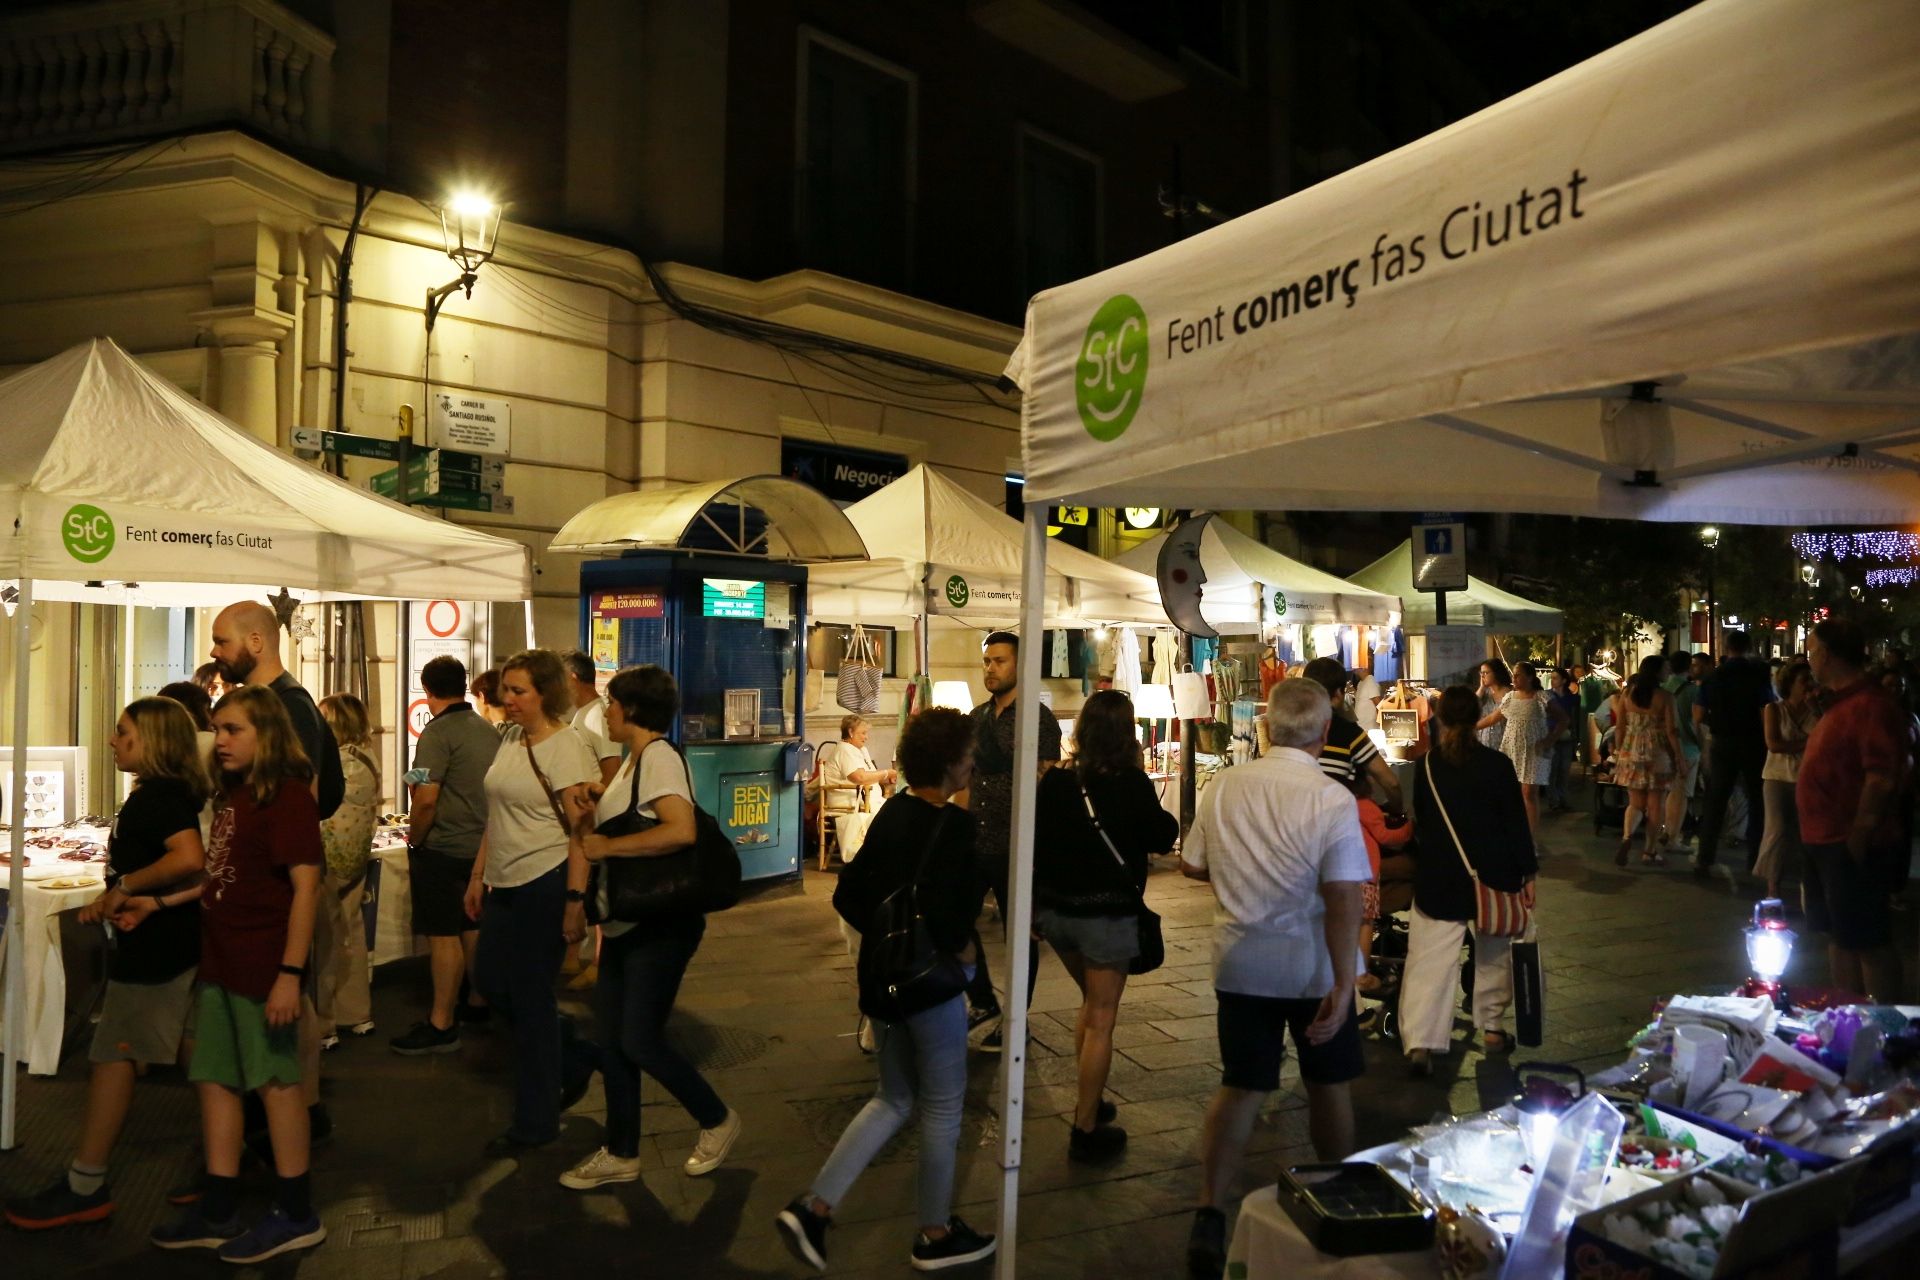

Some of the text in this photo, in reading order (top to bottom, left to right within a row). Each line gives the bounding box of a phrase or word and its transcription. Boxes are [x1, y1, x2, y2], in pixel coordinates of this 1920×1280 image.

[1168, 169, 1588, 359] Fent comerç fas Ciutat
[1084, 317, 1141, 391] StC
[448, 411, 474, 421] SANTIAGO
[68, 514, 108, 544] StC
[126, 526, 273, 549] Fent comerç fas Ciutat
[948, 581, 966, 598] StC
[971, 588, 986, 599] Fent
[987, 590, 1012, 602] comerç
[416, 711, 431, 727] 10
[734, 785, 771, 804] BEN
[729, 802, 770, 827] JUGAT
